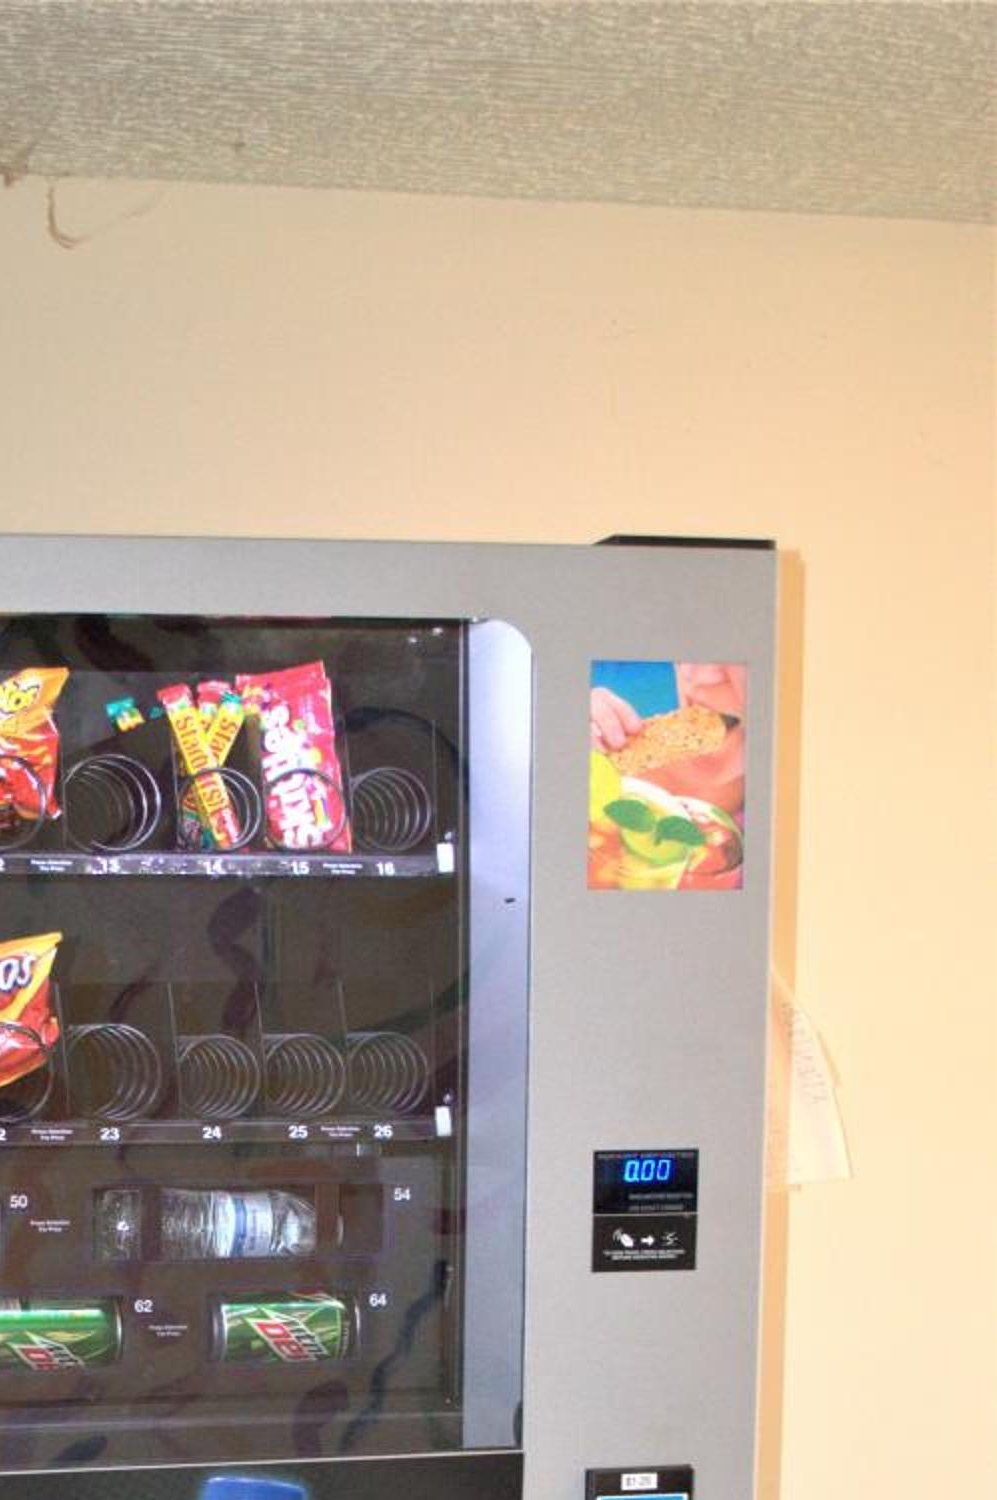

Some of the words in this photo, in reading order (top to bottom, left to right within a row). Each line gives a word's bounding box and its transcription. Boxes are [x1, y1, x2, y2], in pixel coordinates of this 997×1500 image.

[290, 859, 309, 875] 15
[375, 861, 394, 876] 16
[101, 1127, 119, 1141] 23
[203, 1126, 221, 1140] 24
[289, 1126, 308, 1139] 25
[374, 1125, 392, 1139] 26
[624, 1159, 671, 1182] 0.00
[394, 1188, 410, 1201] 54
[10, 1195, 27, 1209] 50
[134, 1299, 153, 1313] 62
[369, 1293, 387, 1307] 64
